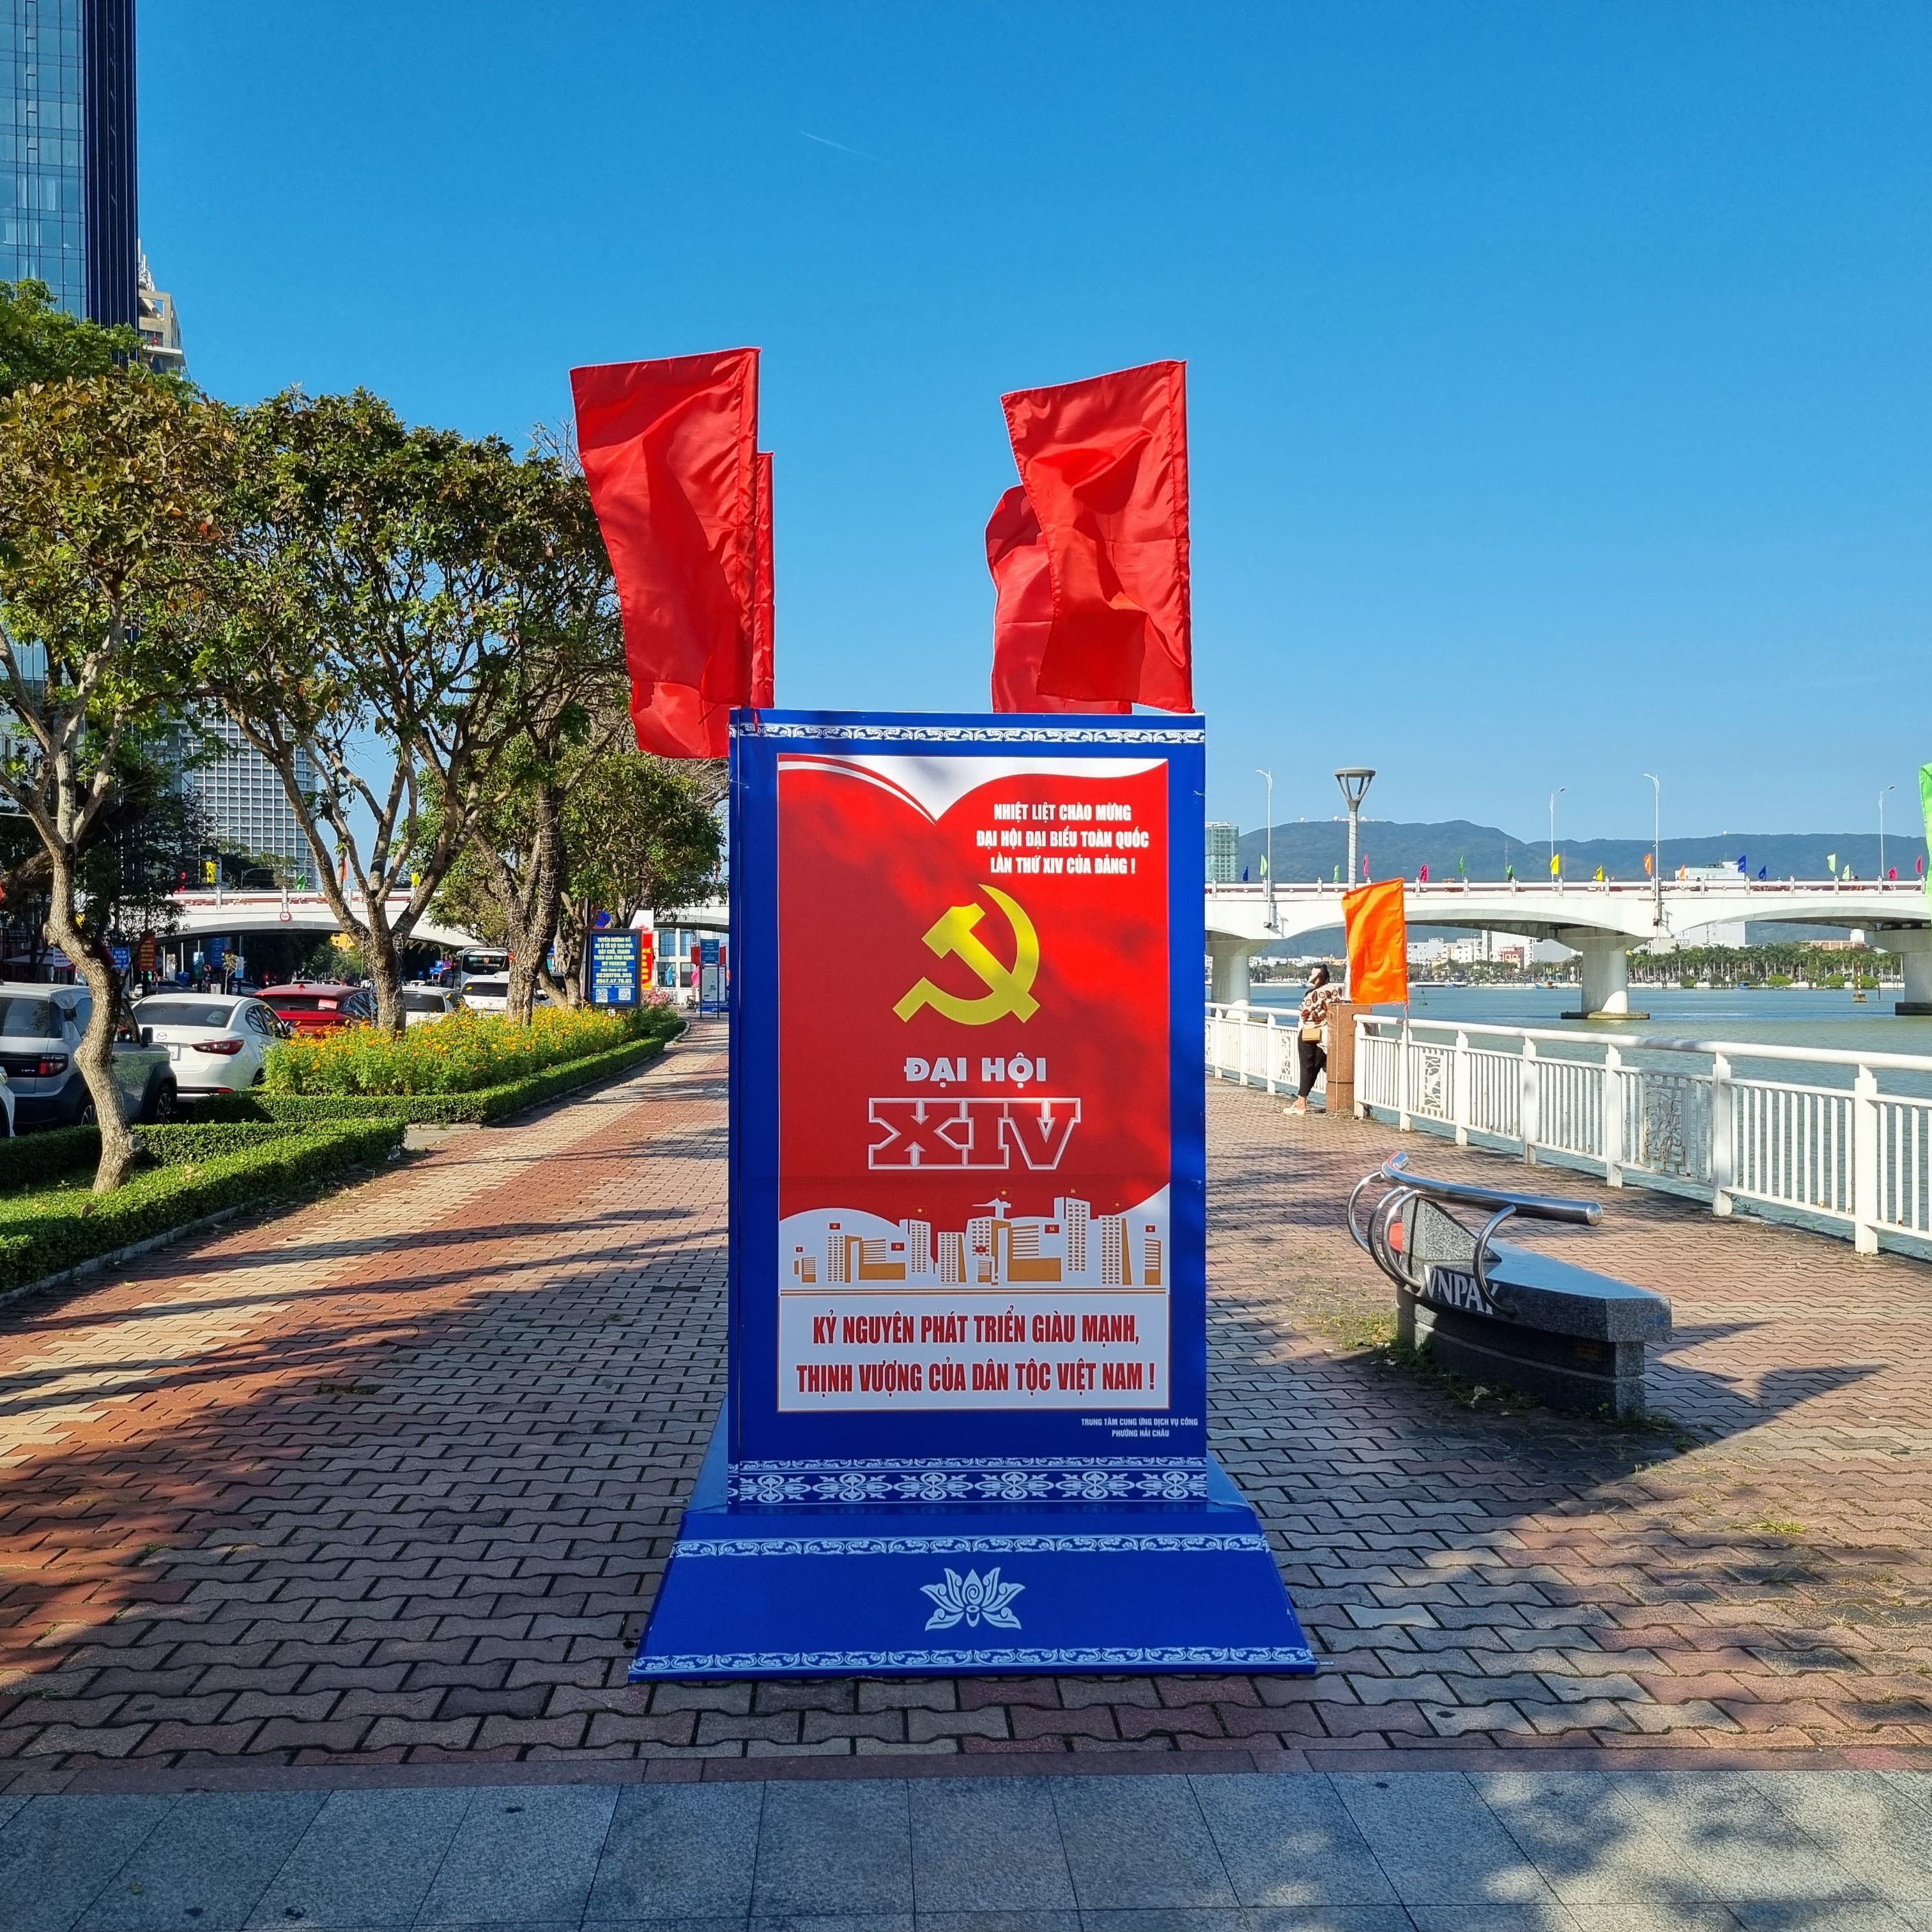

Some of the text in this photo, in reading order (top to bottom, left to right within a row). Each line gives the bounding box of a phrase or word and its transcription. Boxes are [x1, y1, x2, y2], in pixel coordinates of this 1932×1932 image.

[993, 801, 1131, 823] NHIỆT LIỆT CHÀO MỪNG
[976, 825, 1149, 850] ĐẠI HỘI ĐẠI BIỂU TOÀN QUỐC
[990, 852, 1013, 873] LẦN
[1015, 855, 1041, 873] THỨ
[1043, 857, 1064, 873] XIV
[1066, 854, 1092, 874] CỦA
[1094, 854, 1128, 874] ĐẢNG
[903, 1052, 1046, 1088] ĐẠI HỘI
[868, 1097, 1081, 1170] XIV
[813, 1305, 1139, 1347] KỶ NGUYÊN PHÁT TRIỂN GIÀU MẠNH,
[796, 1365, 852, 1397] THỊNH
[858, 1360, 922, 1397] VƯỢNG
[928, 1357, 966, 1391] CỦA
[972, 1359, 1009, 1391] DÂN
[1015, 1358, 1051, 1395] TỘC
[1057, 1358, 1096, 1395] VIỆT
[1102, 1363, 1142, 1390] NAM
[1103, 1417, 1118, 1425] TÂM
[1153, 1418, 1169, 1427] DỊCH
[1170, 1418, 1179, 1427] VỤ
[1180, 1417, 1199, 1425] CÔNG
[1112, 1427, 1170, 1438] PHƯỜNG HẢI CHÂU
